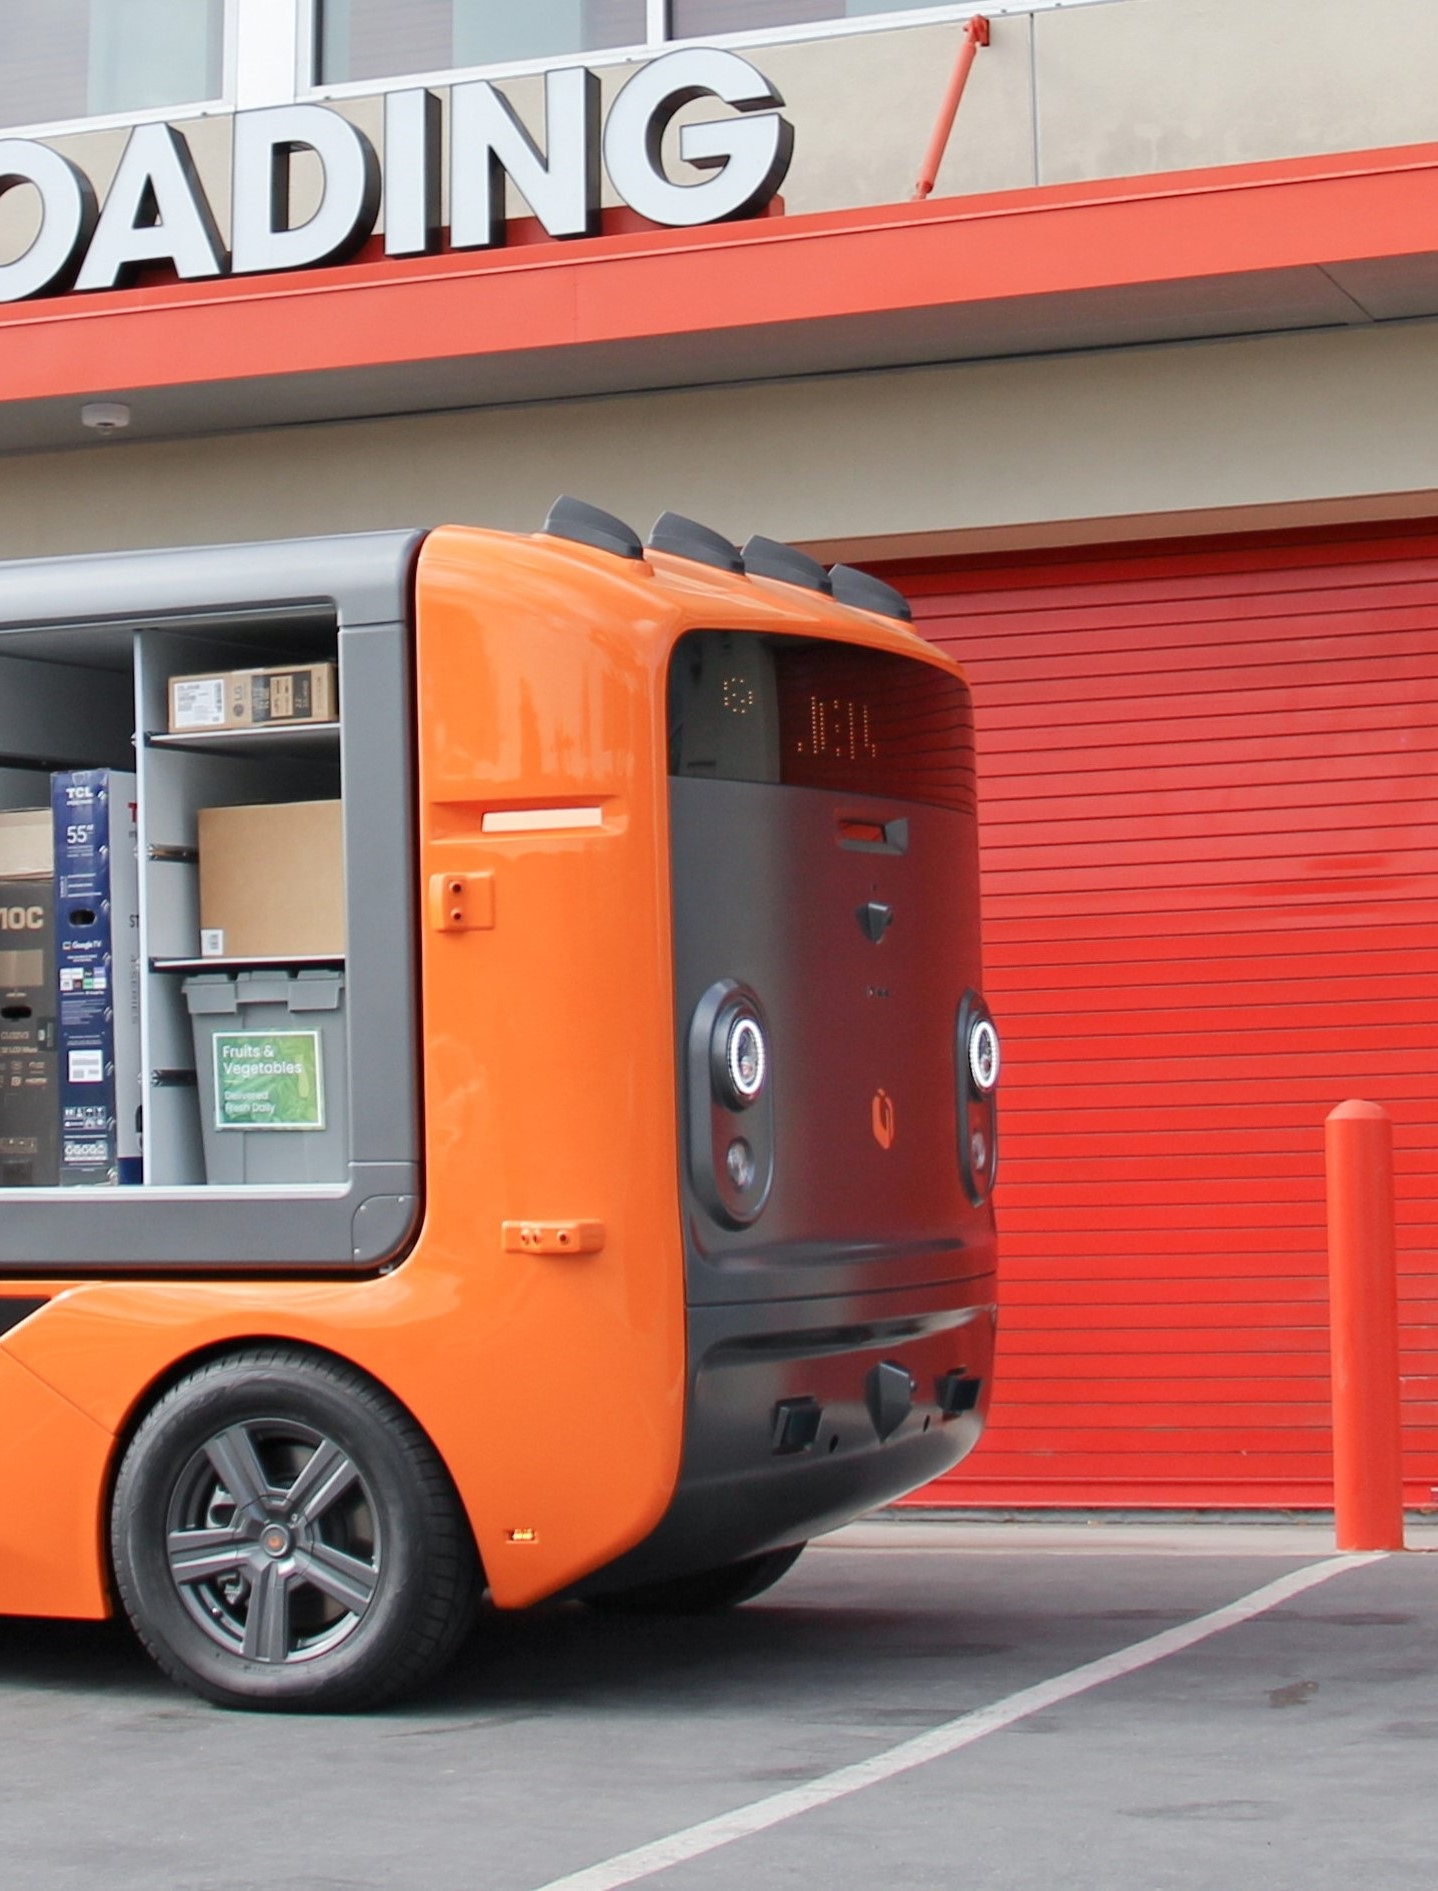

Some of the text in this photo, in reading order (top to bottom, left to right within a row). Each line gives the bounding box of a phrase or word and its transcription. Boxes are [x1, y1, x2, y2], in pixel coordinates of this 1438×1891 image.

[66, 787, 94, 799] TCL
[222, 1043, 275, 1058] Fruits &
[222, 1060, 303, 1078] Vegetables
[252, 1103, 276, 1114] Daily
